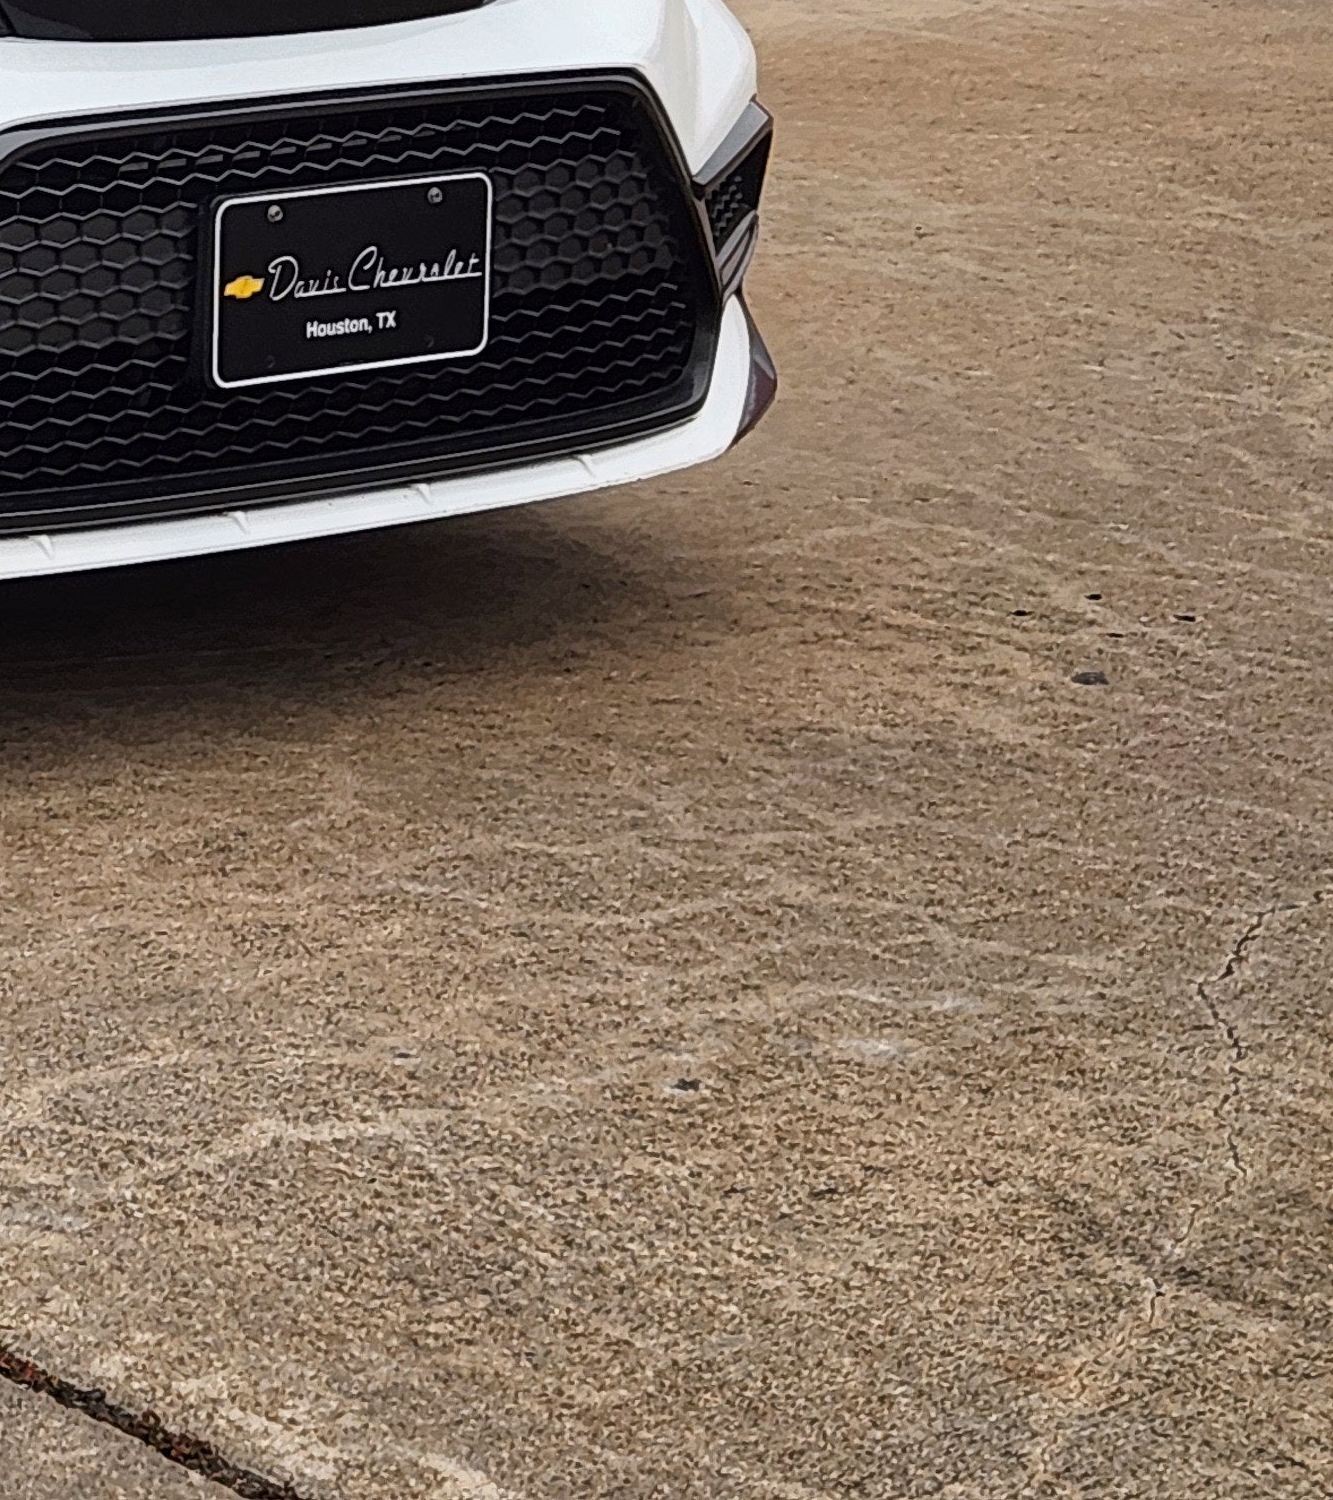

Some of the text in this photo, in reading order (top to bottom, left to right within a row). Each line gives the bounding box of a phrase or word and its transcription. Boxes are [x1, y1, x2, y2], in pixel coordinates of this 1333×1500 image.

[268, 246, 482, 301] Davis Chevrolet
[306, 310, 397, 339] Houston, TX
